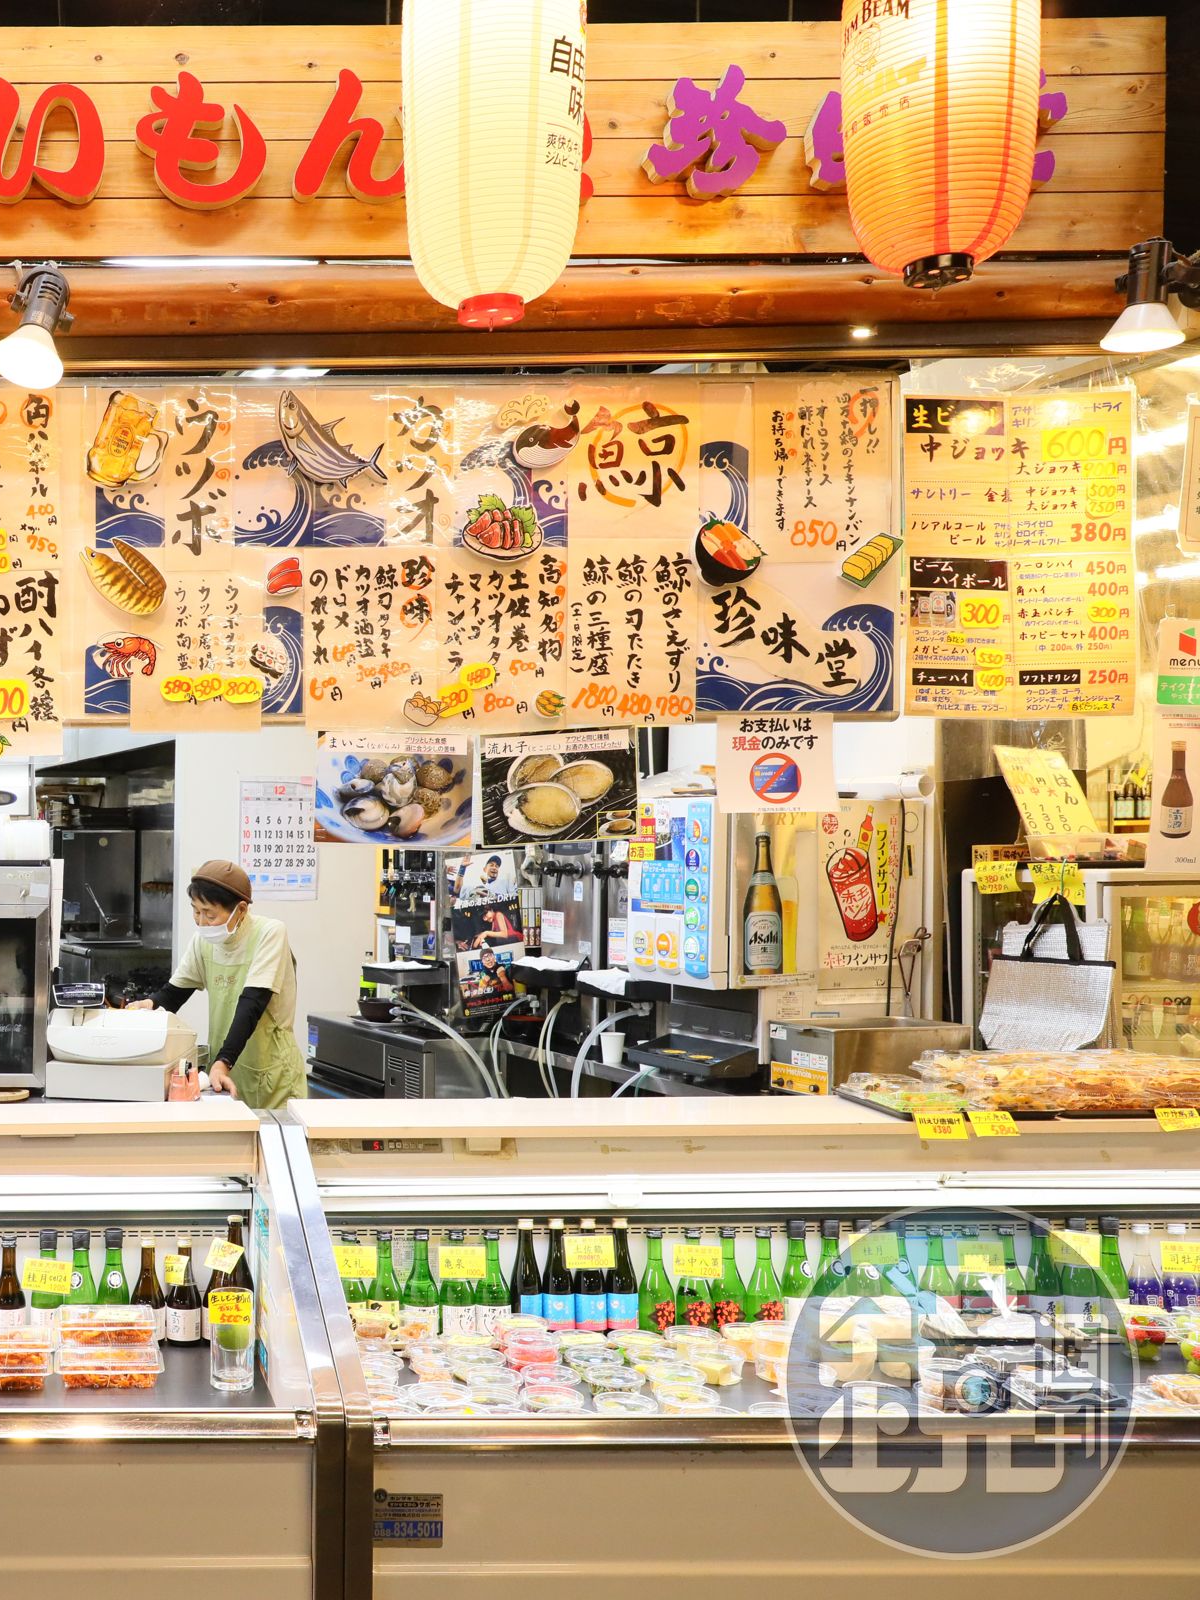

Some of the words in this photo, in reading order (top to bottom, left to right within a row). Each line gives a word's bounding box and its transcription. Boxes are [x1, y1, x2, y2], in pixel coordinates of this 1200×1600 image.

[577, 400, 690, 507] 鯨
[920, 435, 1030, 463] 中ジョッキ
[392, 395, 446, 543] カツオ
[1016, 462, 1082, 476] 大ジョッキ
[171, 398, 227, 556] ウツボ
[910, 487, 972, 501] サントリー
[1025, 486, 1078, 497] 中ジョッキ
[1026, 500, 1078, 511] 大ジョッキ
[911, 521, 987, 532] ノンアルコール
[1070, 523, 1127, 543] 380円
[790, 519, 847, 551] 850円
[949, 533, 987, 546] ビール
[912, 559, 954, 572] ビーム
[1013, 559, 1073, 570] ウーロンハイ
[1086, 560, 1127, 574] 450円
[932, 573, 1007, 589] ハイボール
[333, 565, 351, 629] ドロメ
[401, 555, 436, 624] 珍味
[1016, 585, 1046, 596] 角ハイ
[1087, 582, 1129, 597] 400円
[504, 569, 531, 653] 土佐巻
[537, 554, 563, 663] 高知名物
[1017, 607, 1075, 618] 赤玉パンチ
[309, 568, 330, 666] のれそれ
[651, 552, 693, 693] 鯨のさえずり
[711, 585, 858, 688] 珍味堂
[1019, 629, 1086, 641] ホッピーセット
[1087, 625, 1129, 641] 400円
[14, 570, 60, 723] 酎ハイ各種
[916, 672, 969, 684] チューハイ
[1022, 673, 1079, 683] ソフトドリンク
[1088, 669, 1129, 684] 250円
[739, 717, 812, 733] お支払いは
[328, 736, 366, 749] まいご
[487, 740, 527, 755] 流れ子
[732, 734, 819, 751] 現金のみです
[748, 931, 779, 946] Asahi
